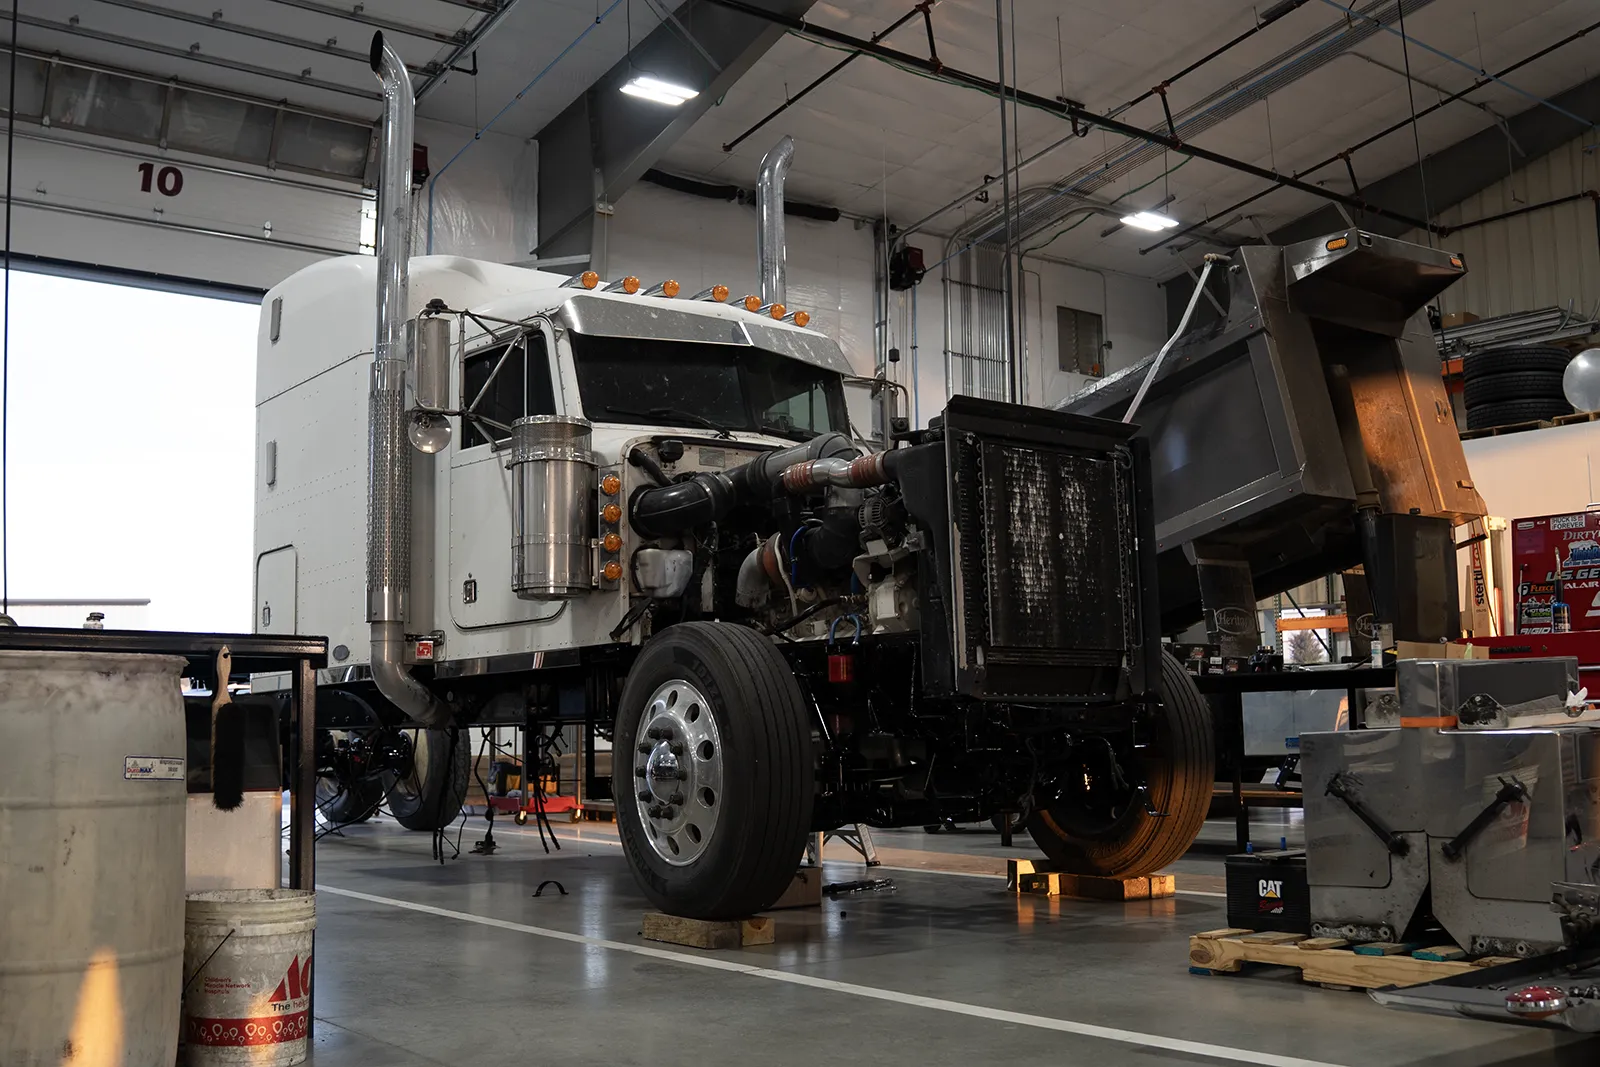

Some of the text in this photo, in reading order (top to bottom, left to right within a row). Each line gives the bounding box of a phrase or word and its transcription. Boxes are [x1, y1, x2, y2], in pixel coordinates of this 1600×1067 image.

[138, 162, 183, 197] 10
[1553, 521, 1584, 529] FOREVER
[1474, 569, 1485, 605] stertil
[1258, 879, 1284, 898] CAT
[271, 1003, 291, 1012] The
